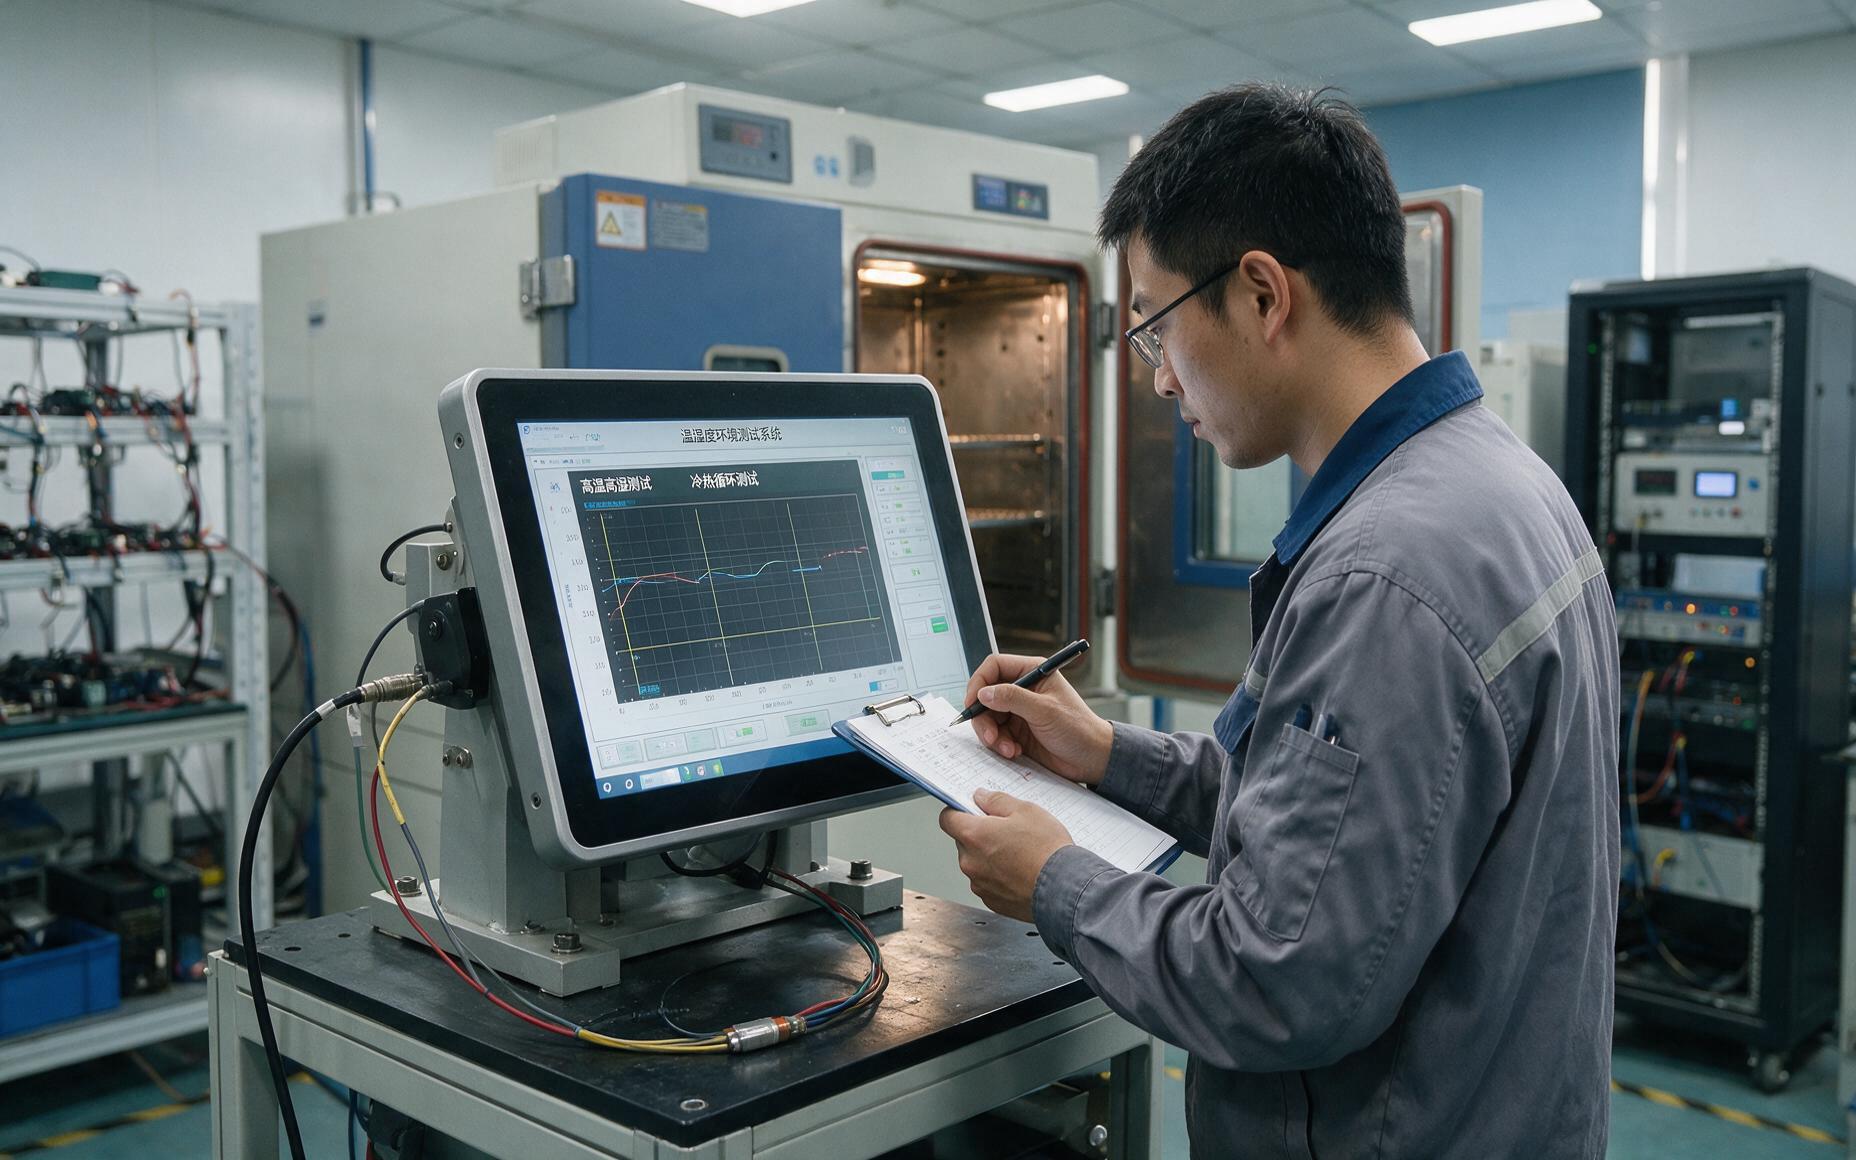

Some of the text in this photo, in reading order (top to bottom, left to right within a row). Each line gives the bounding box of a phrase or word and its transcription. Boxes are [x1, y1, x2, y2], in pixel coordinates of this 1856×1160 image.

[681, 426, 782, 443] 温湿度环境测试系统
[580, 475, 652, 494] 高温高湿测试
[690, 470, 759, 489] 冷热循环测试
